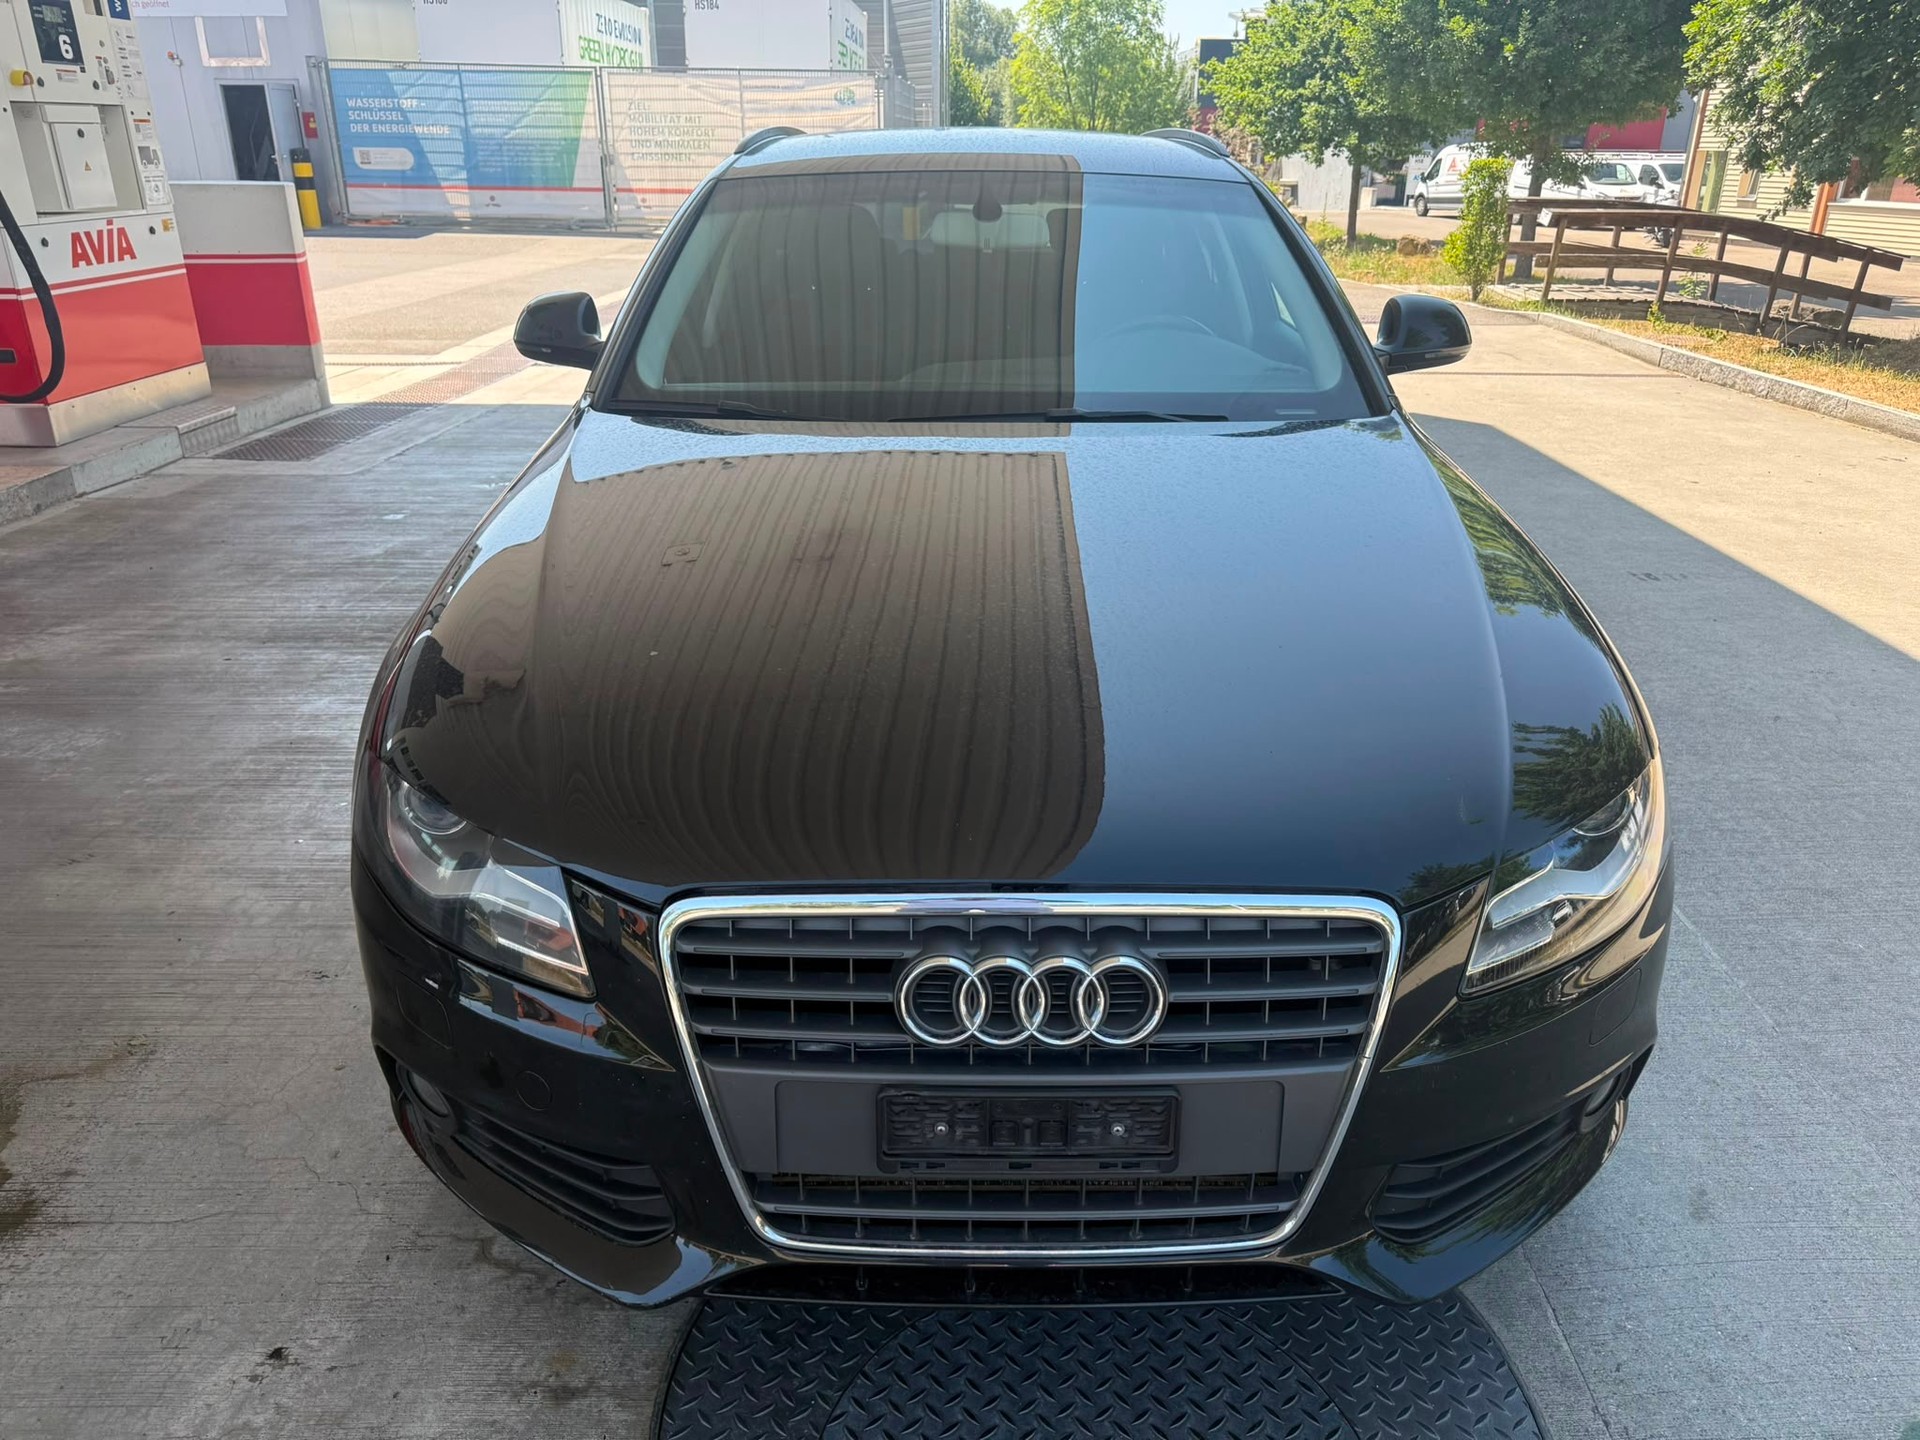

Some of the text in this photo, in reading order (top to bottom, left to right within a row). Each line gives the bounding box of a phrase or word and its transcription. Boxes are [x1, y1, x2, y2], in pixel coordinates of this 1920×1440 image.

[58, 34, 74, 60] 6
[346, 97, 418, 108] WASSERSTOFF
[348, 108, 404, 120] SCHLÜSSEL
[684, 115, 703, 124] MIT
[350, 123, 451, 134] DER ENERGIEWENDE
[629, 126, 716, 138] HOHEM KOMFORT
[630, 139, 711, 150] UND MINIMALEN
